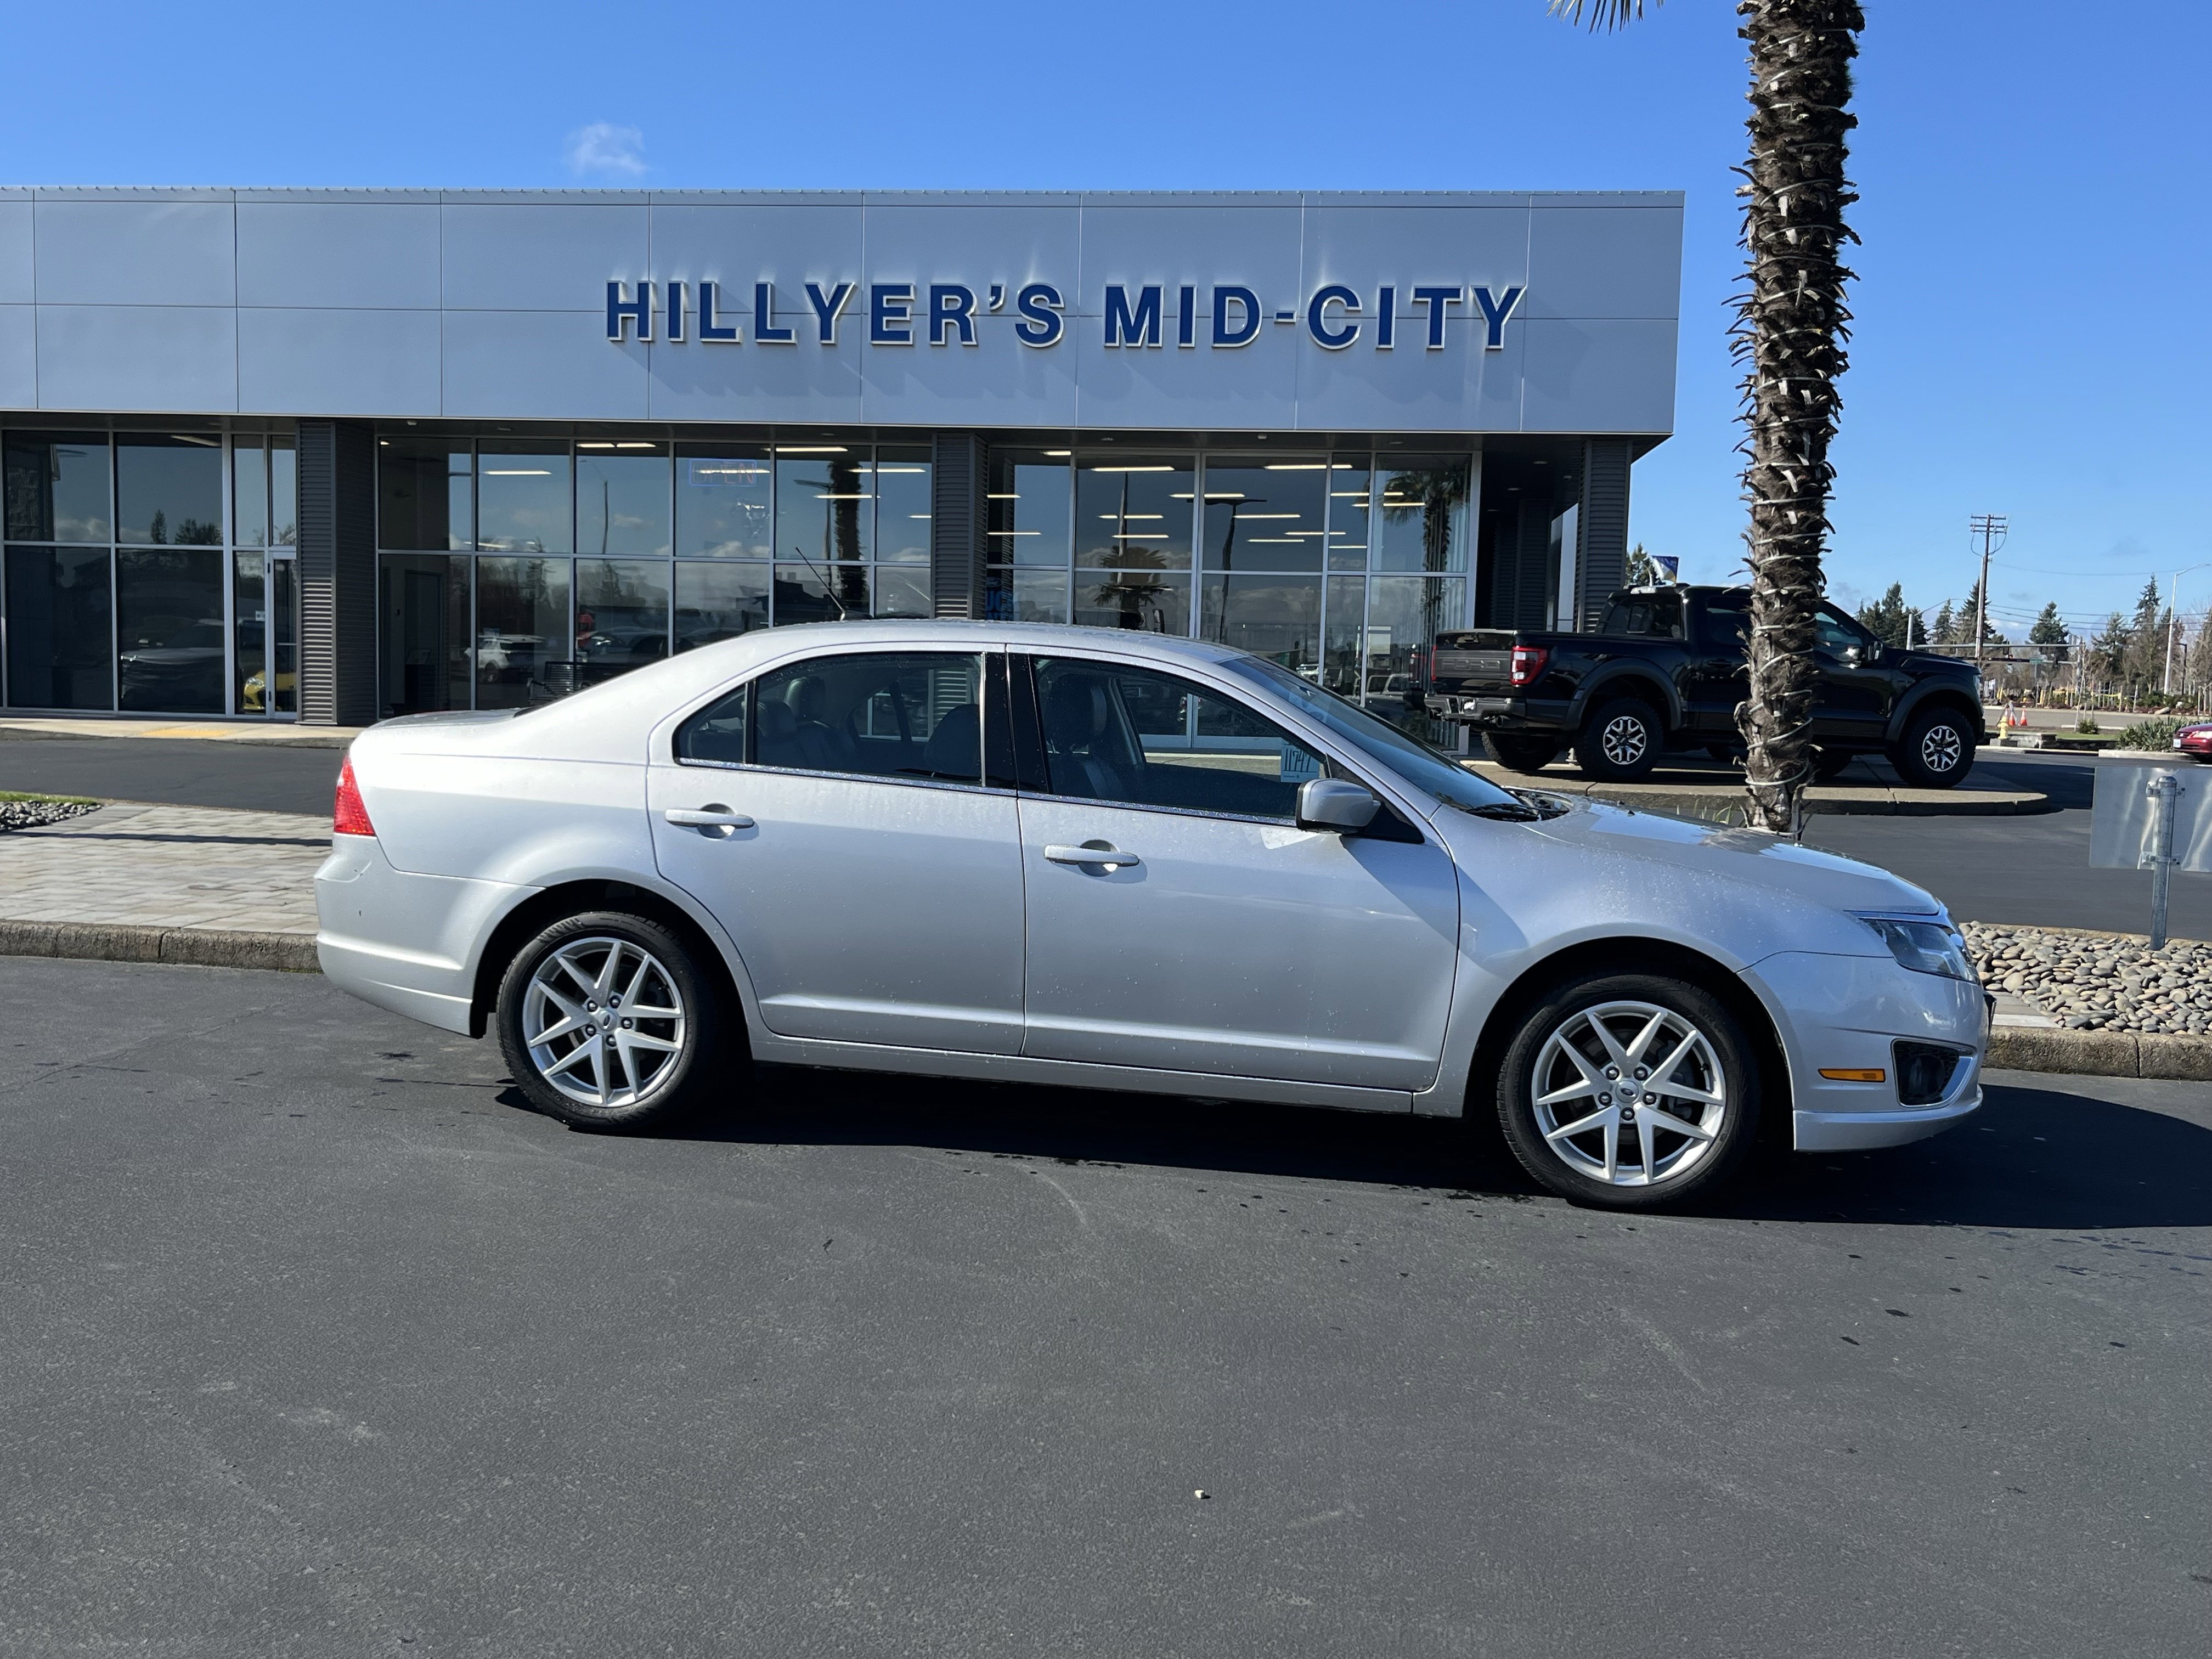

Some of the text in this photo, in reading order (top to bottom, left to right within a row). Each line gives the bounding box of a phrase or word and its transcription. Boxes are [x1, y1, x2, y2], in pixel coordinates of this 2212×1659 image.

[606, 280, 1528, 350] HILLYER'S MID-CITY
[1442, 659, 1500, 672] FORD
